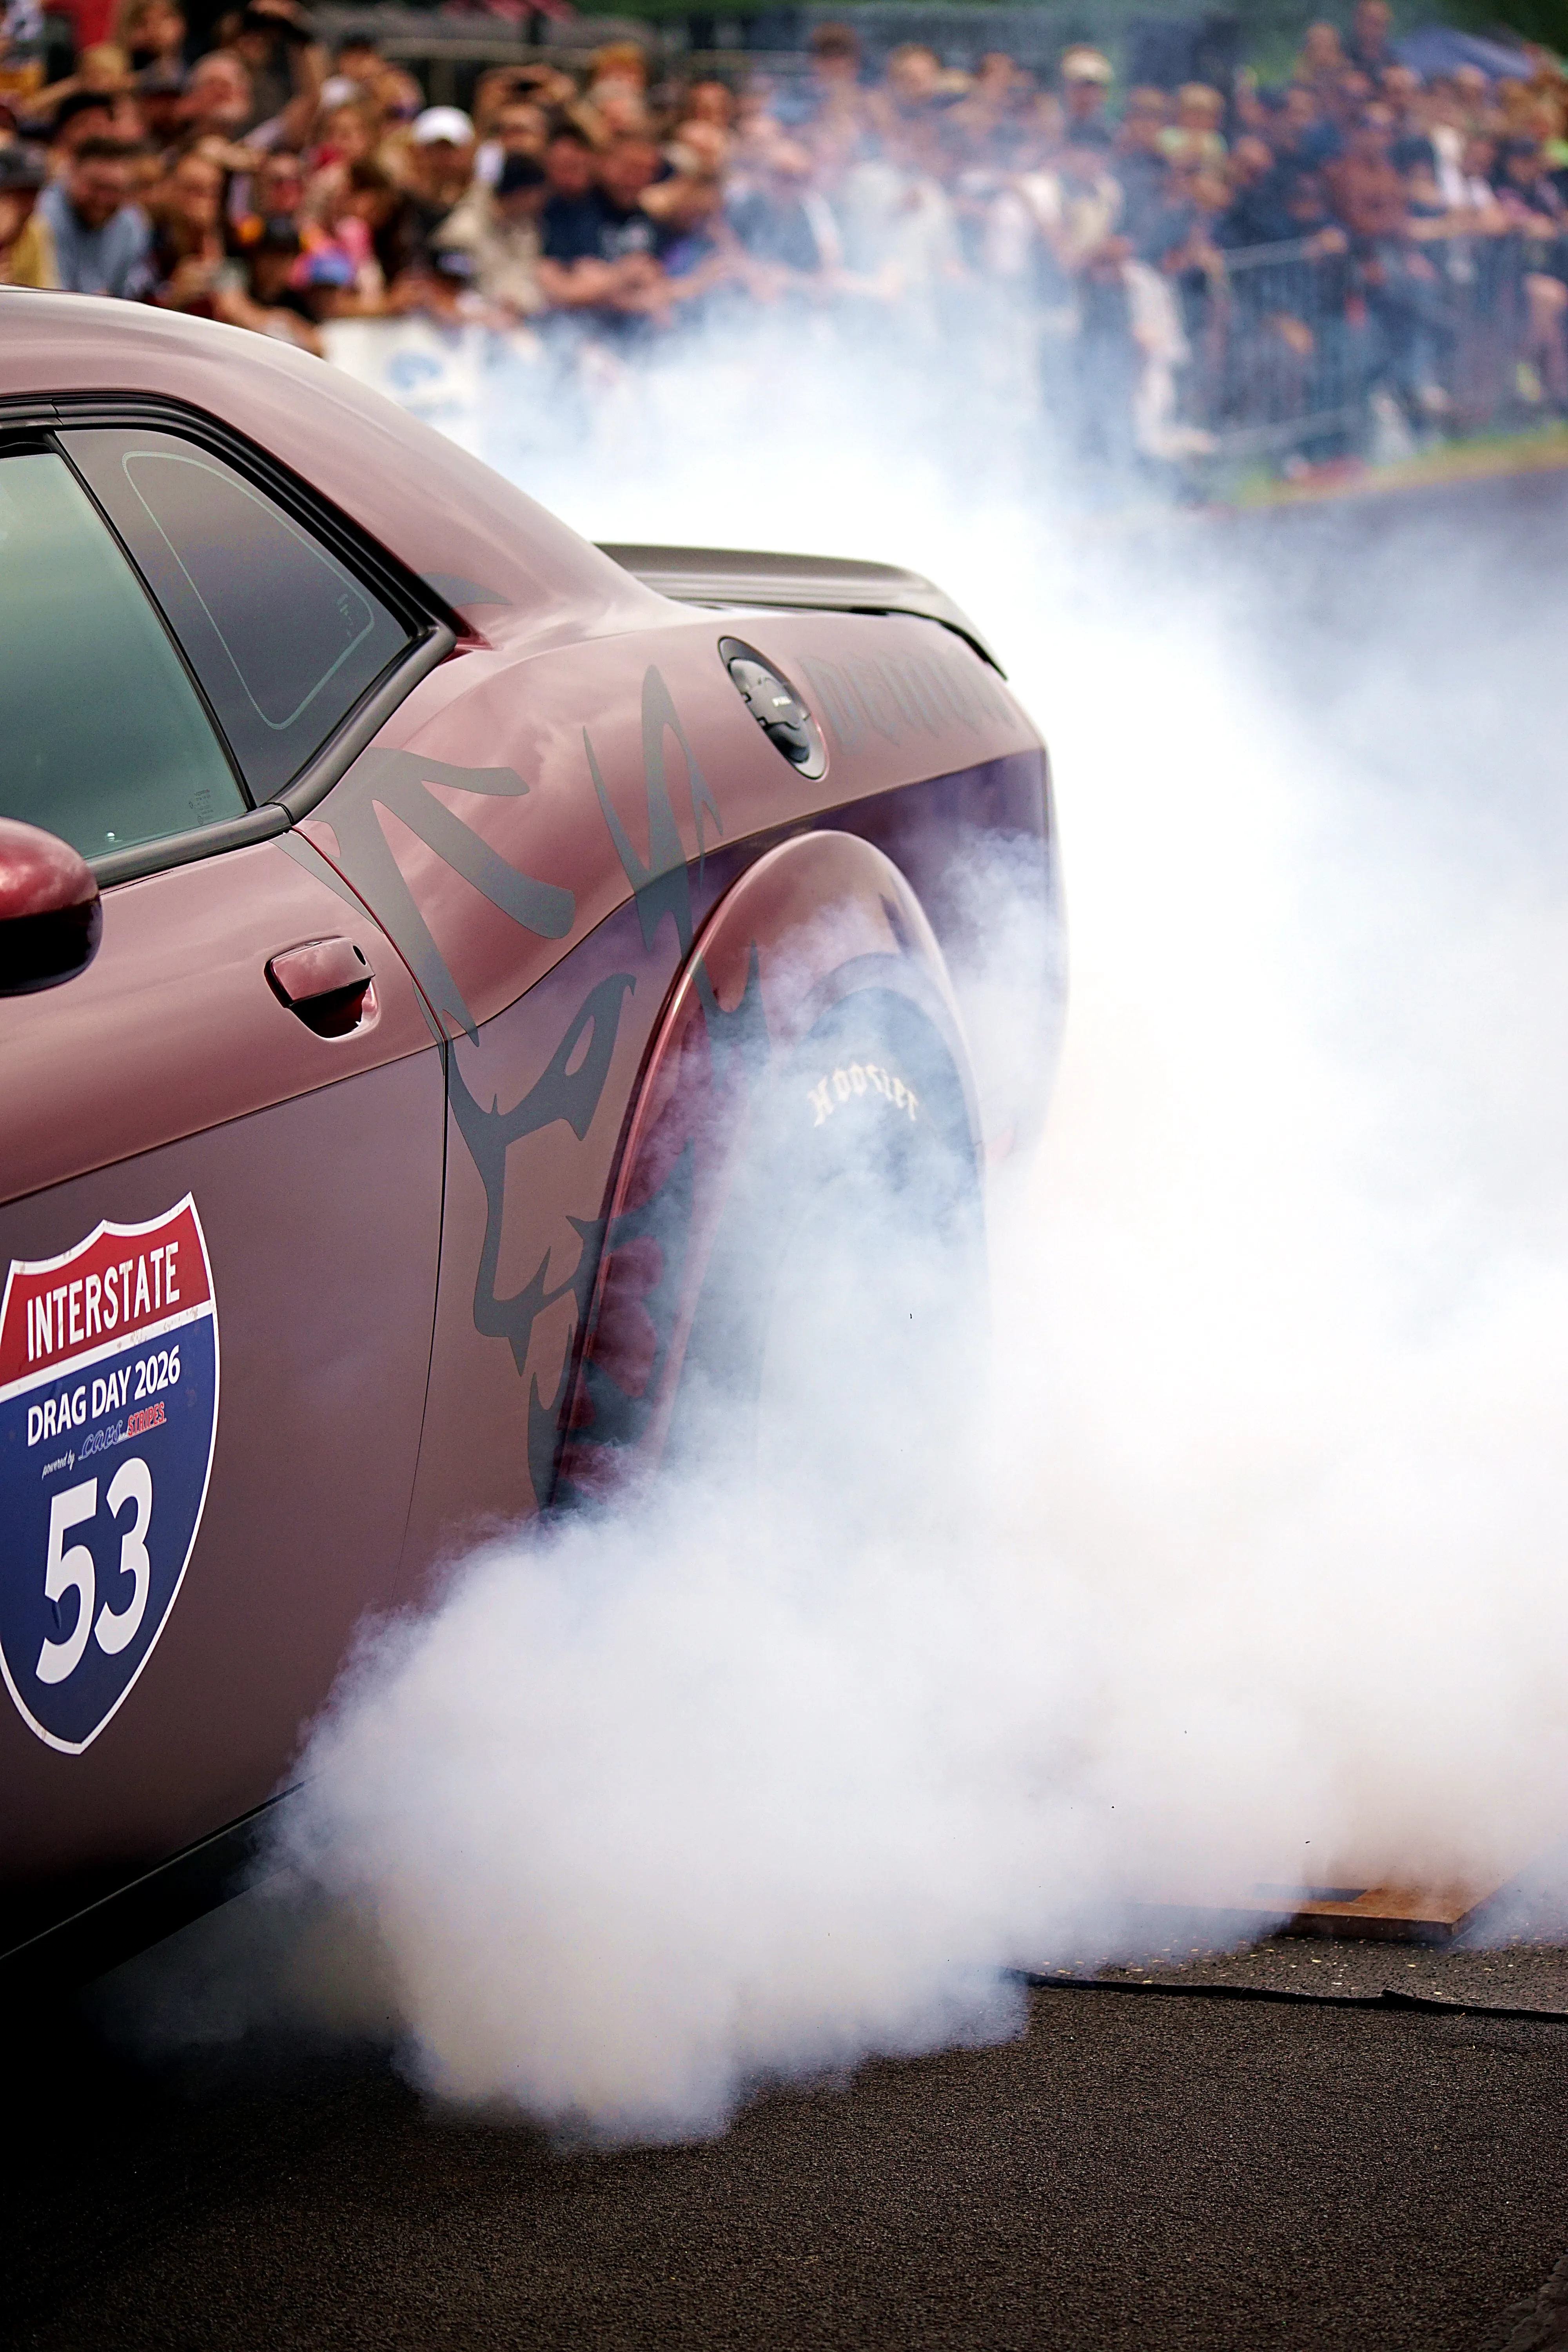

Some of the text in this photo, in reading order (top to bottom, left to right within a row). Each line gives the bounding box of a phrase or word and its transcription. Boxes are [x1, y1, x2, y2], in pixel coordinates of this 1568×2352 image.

[27, 1241, 180, 1362] INTERSTATE
[28, 1345, 180, 1446] DRAG DAY 2026
[42, 1451, 68, 1481] powered
[67, 1449, 74, 1471] by
[128, 1401, 165, 1437] STRIPES
[36, 1457, 152, 1684] 53
